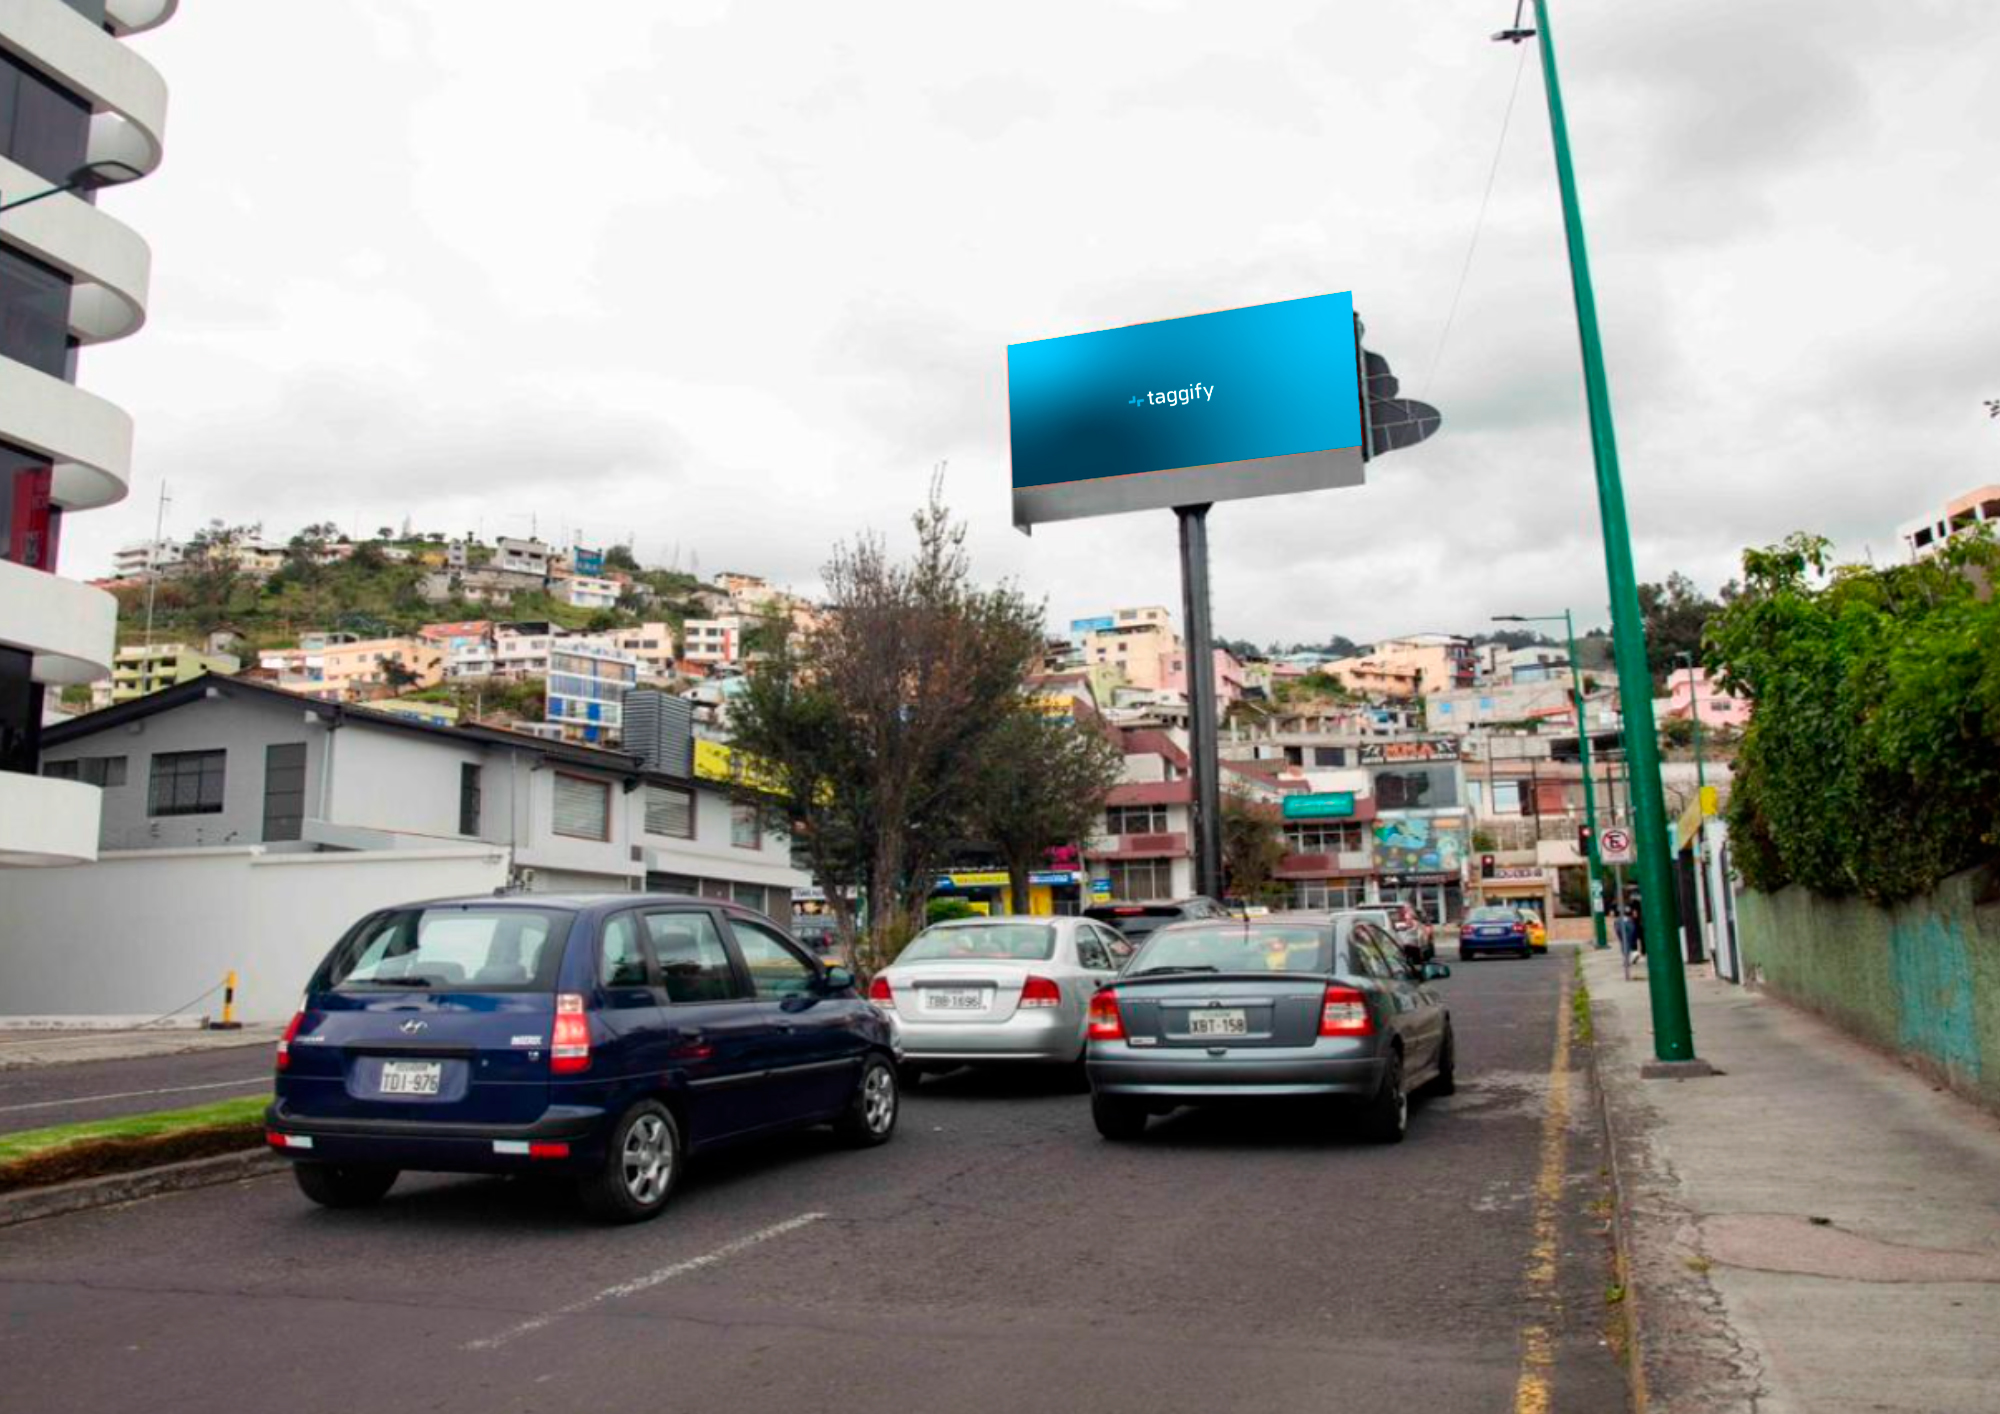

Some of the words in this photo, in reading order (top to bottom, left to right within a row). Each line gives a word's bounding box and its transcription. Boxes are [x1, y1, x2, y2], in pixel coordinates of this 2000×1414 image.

[1147, 382, 1214, 407] taggify
[1191, 1018, 1244, 1033] XBT-158
[384, 1073, 438, 1092] TDI-976
